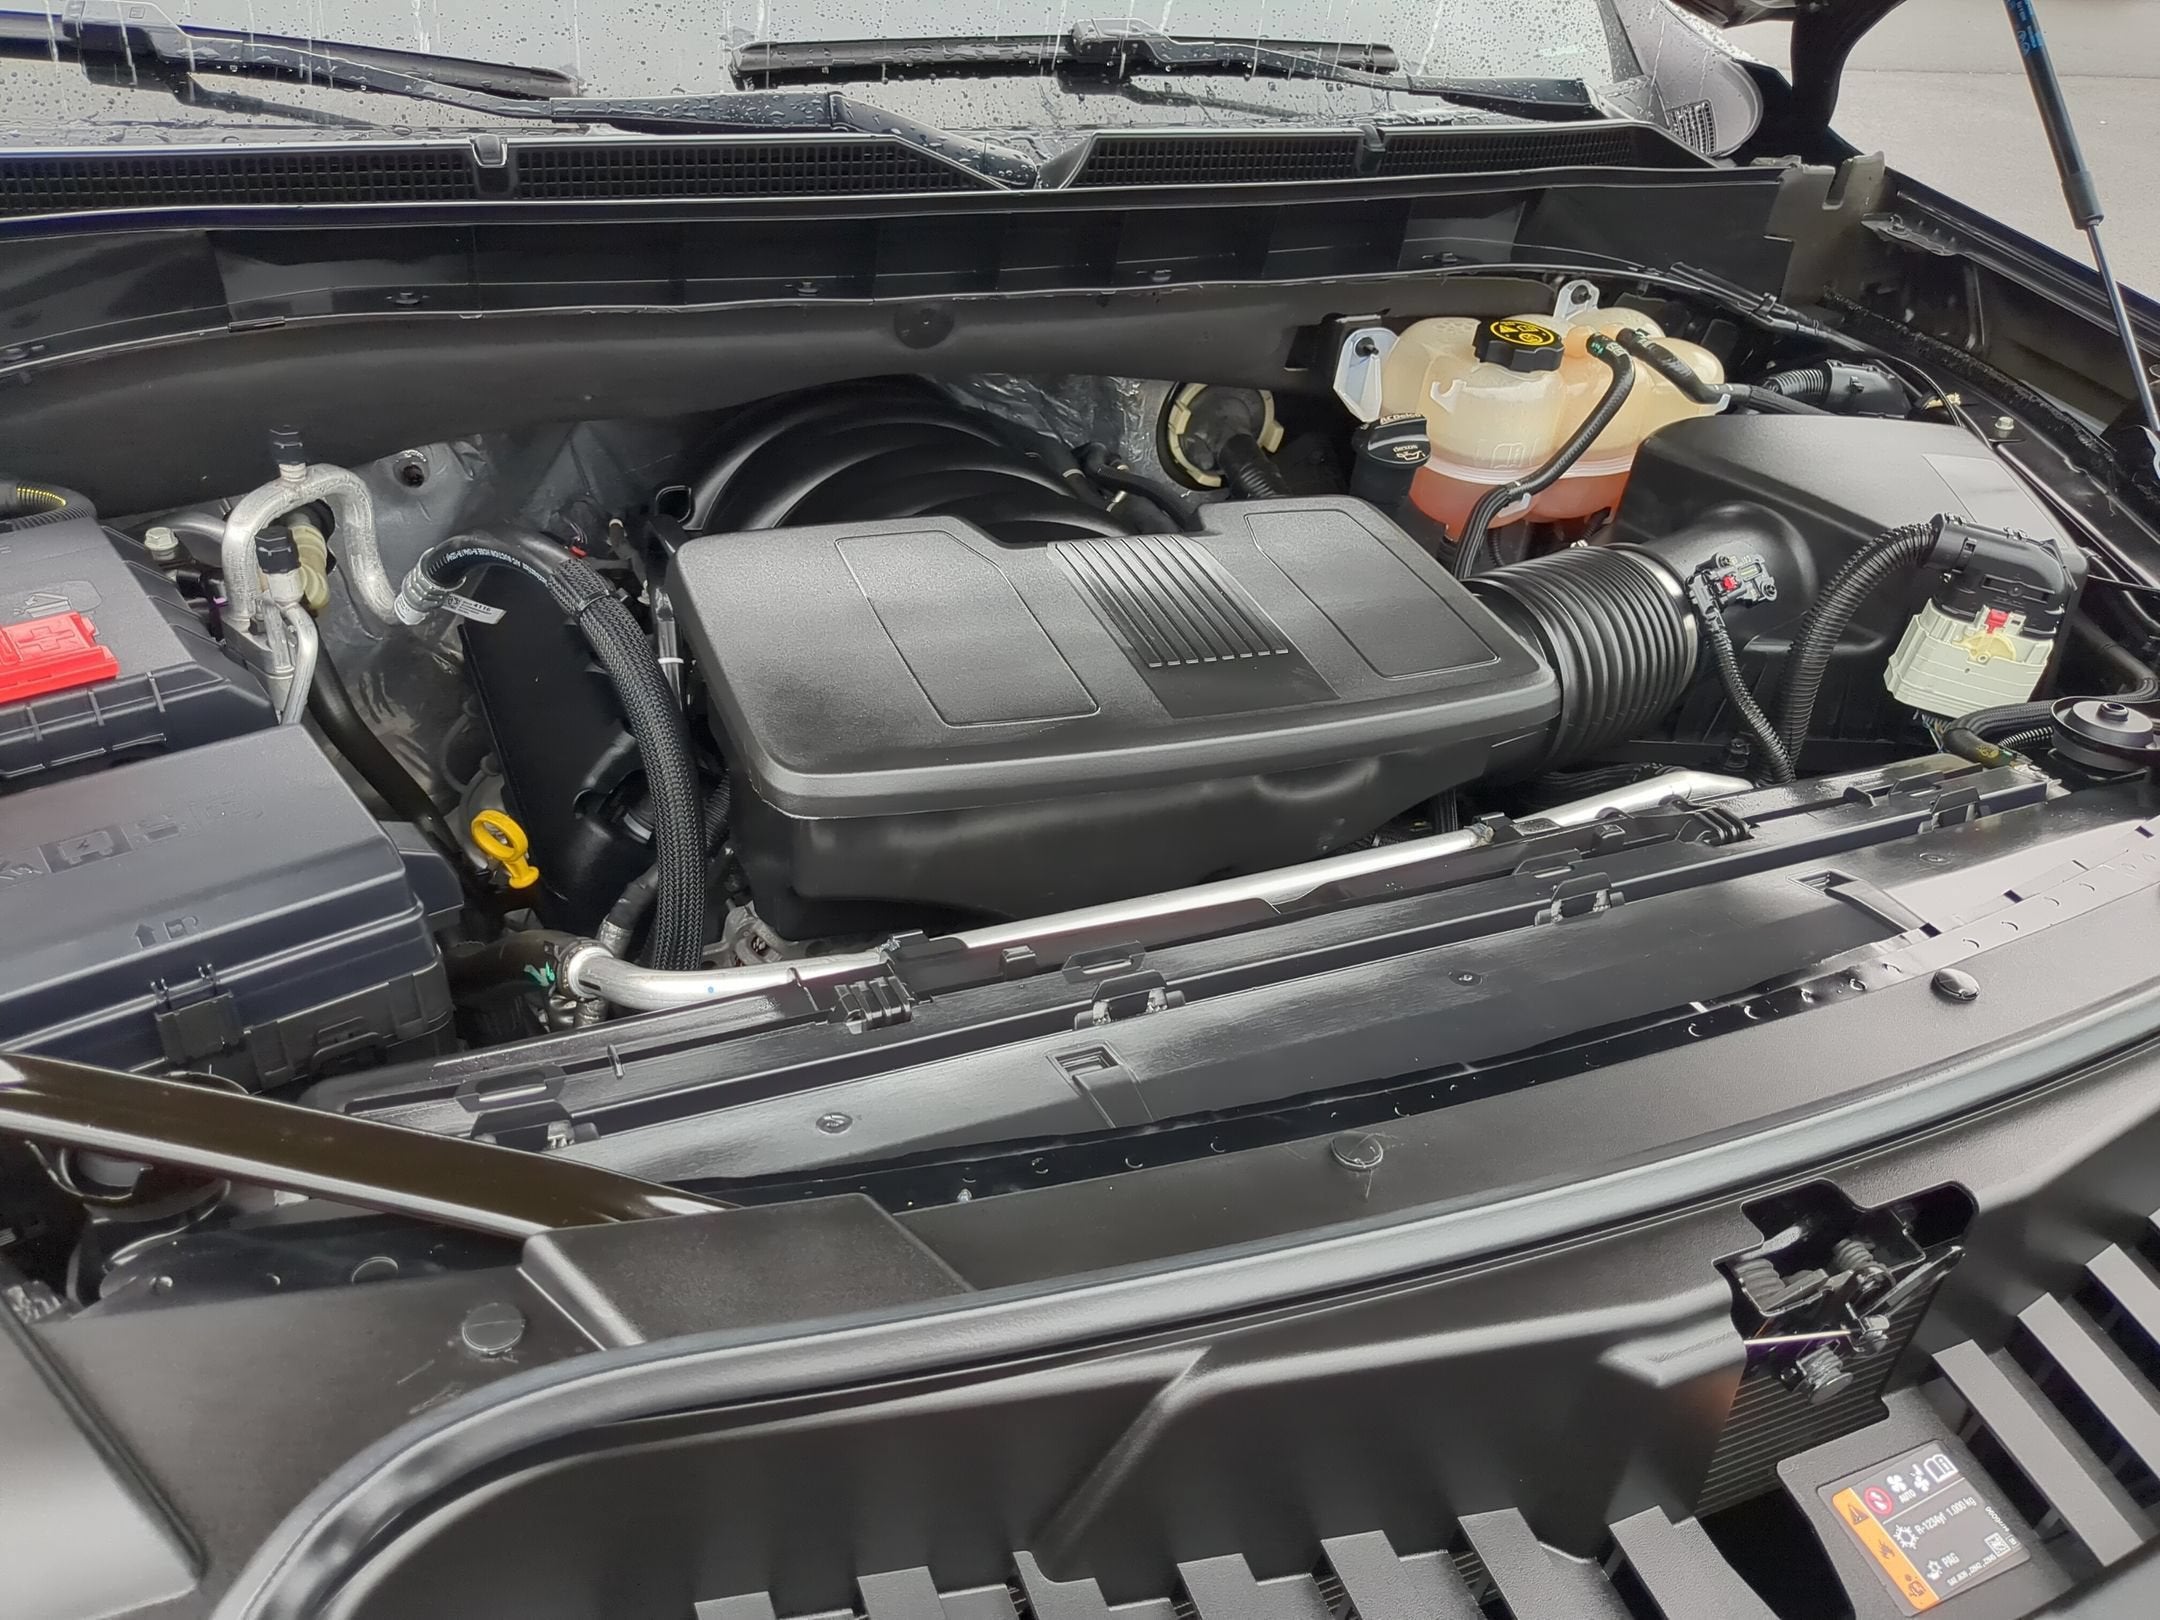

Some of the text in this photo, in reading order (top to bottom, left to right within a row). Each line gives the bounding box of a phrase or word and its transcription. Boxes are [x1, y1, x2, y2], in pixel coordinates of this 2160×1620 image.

[1899, 1489, 1916, 1503] AUTO
[1945, 1500, 1967, 1516] 1.000
[1941, 1552, 1960, 1568] PAG
